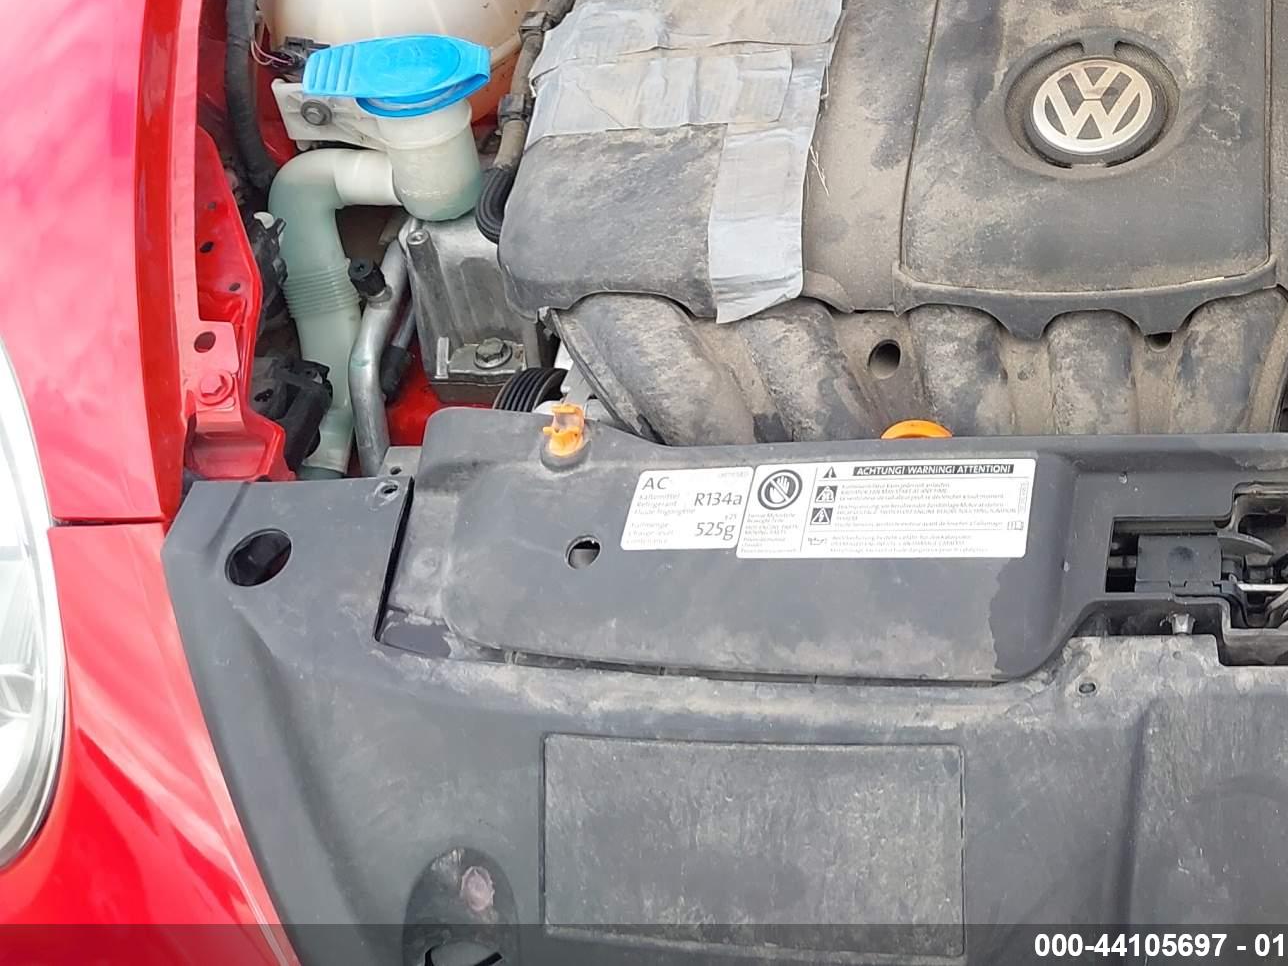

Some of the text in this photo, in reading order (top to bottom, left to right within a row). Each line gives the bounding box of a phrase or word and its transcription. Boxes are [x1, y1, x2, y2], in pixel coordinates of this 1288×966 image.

[1037, 61, 1149, 147] VW
[857, 464, 1011, 476] ACHTUNG! WARNING! ATTENTION!
[641, 476, 670, 490] AC
[694, 491, 743, 506] R134a
[694, 521, 736, 541] 525g
